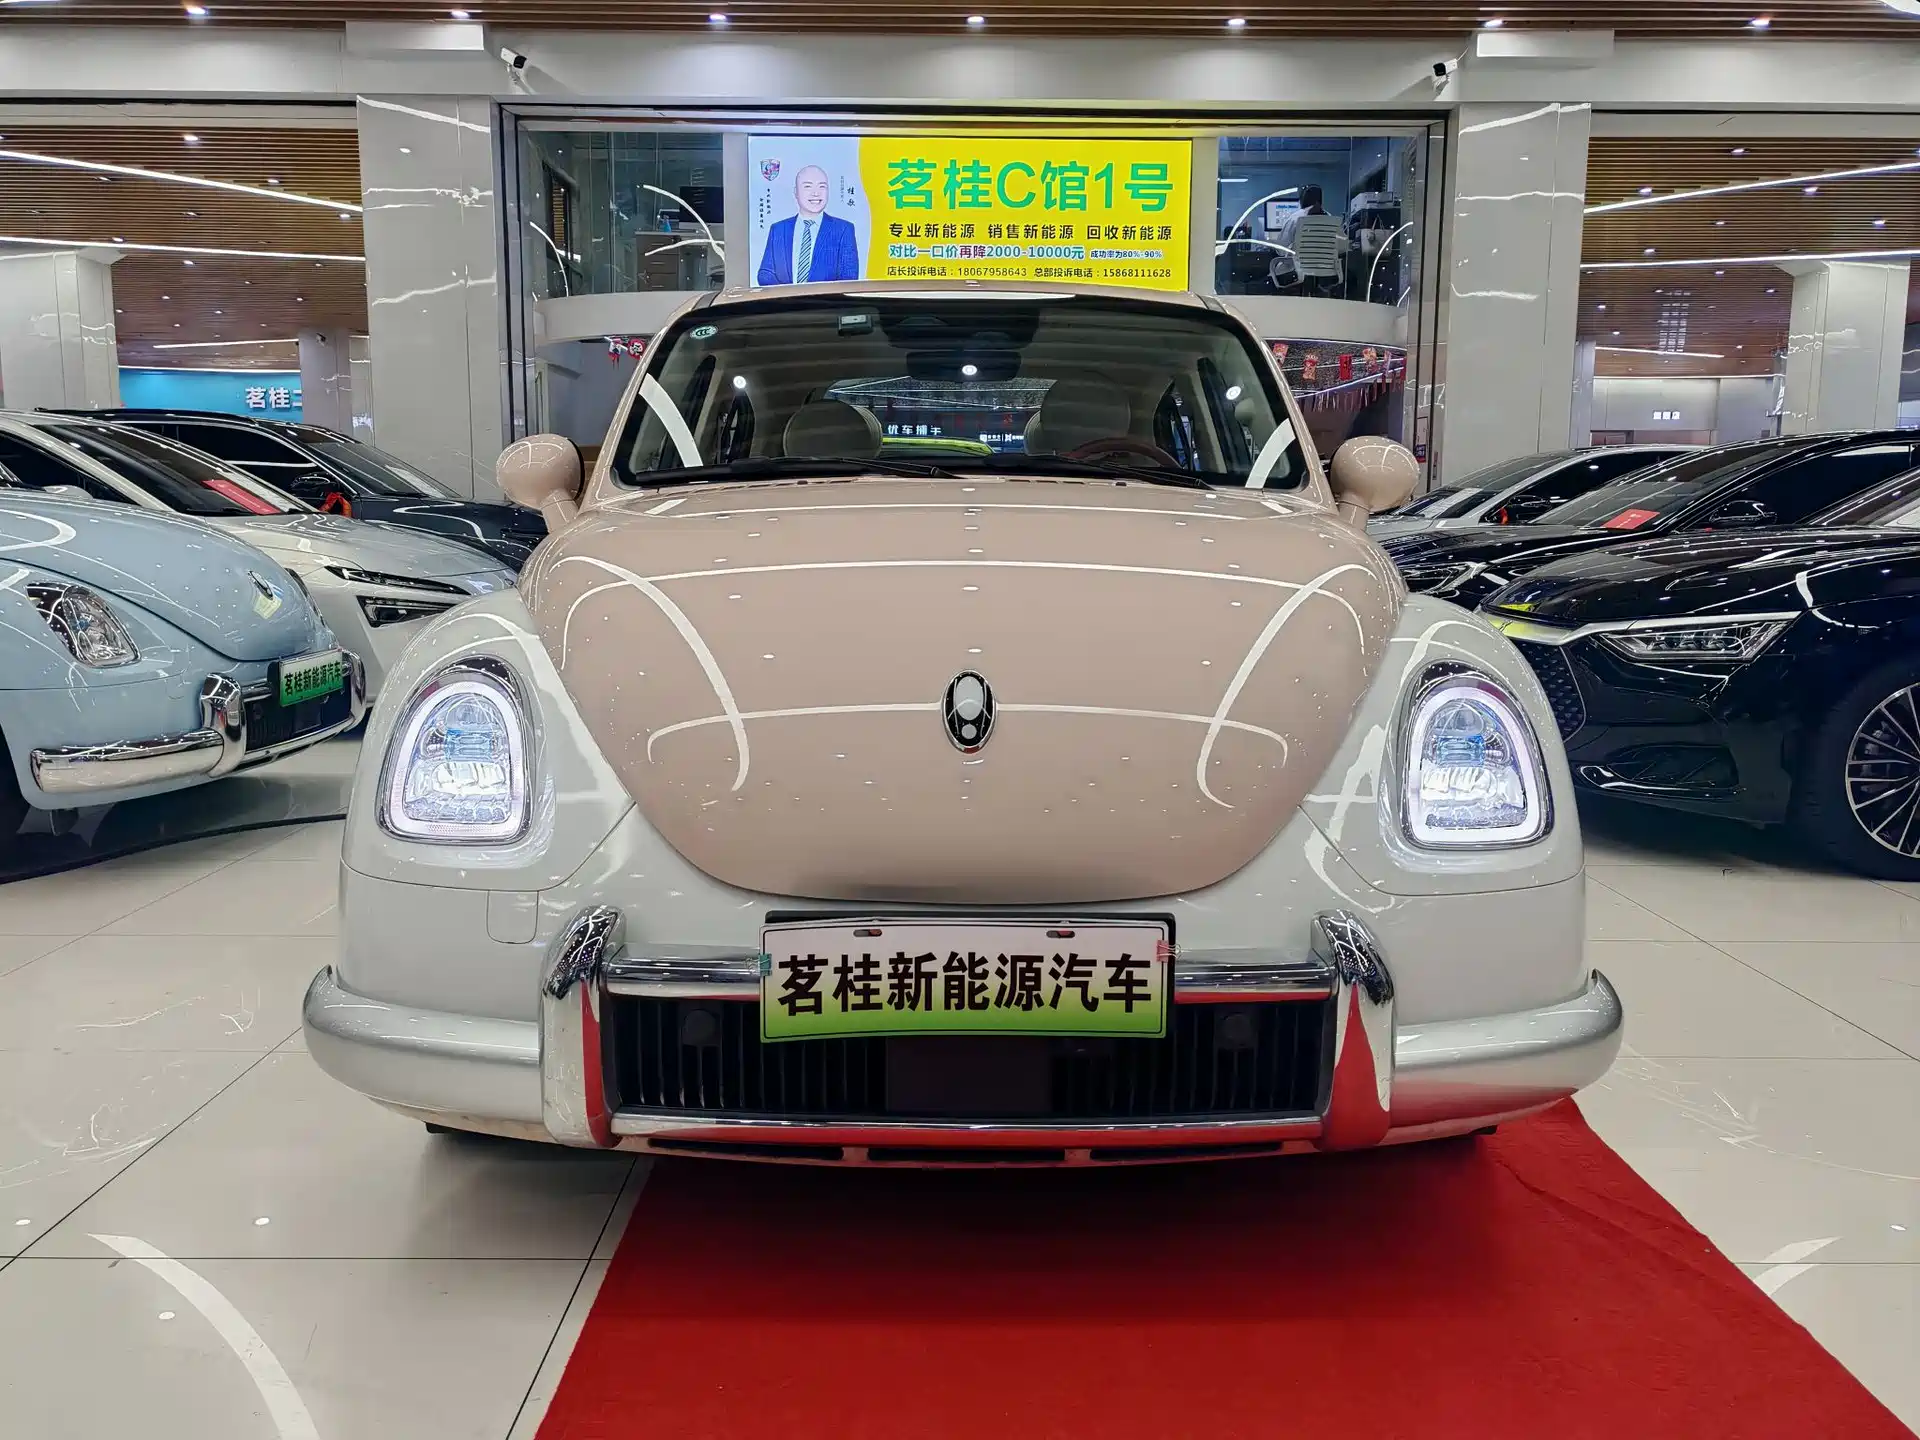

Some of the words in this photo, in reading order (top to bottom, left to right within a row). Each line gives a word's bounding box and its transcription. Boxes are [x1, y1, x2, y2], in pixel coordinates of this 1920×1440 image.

[888, 158, 1173, 212] 茗桂C馆1号
[889, 222, 975, 239] 专业新能源
[988, 223, 1074, 240] 销售新能源
[1087, 225, 1172, 240] 回收新能源
[889, 244, 1085, 260] 对比一口价再降2000-10000元
[284, 660, 341, 696] 茗桂新能源汽车
[777, 951, 1152, 1016] 茗桂新能源汽车
